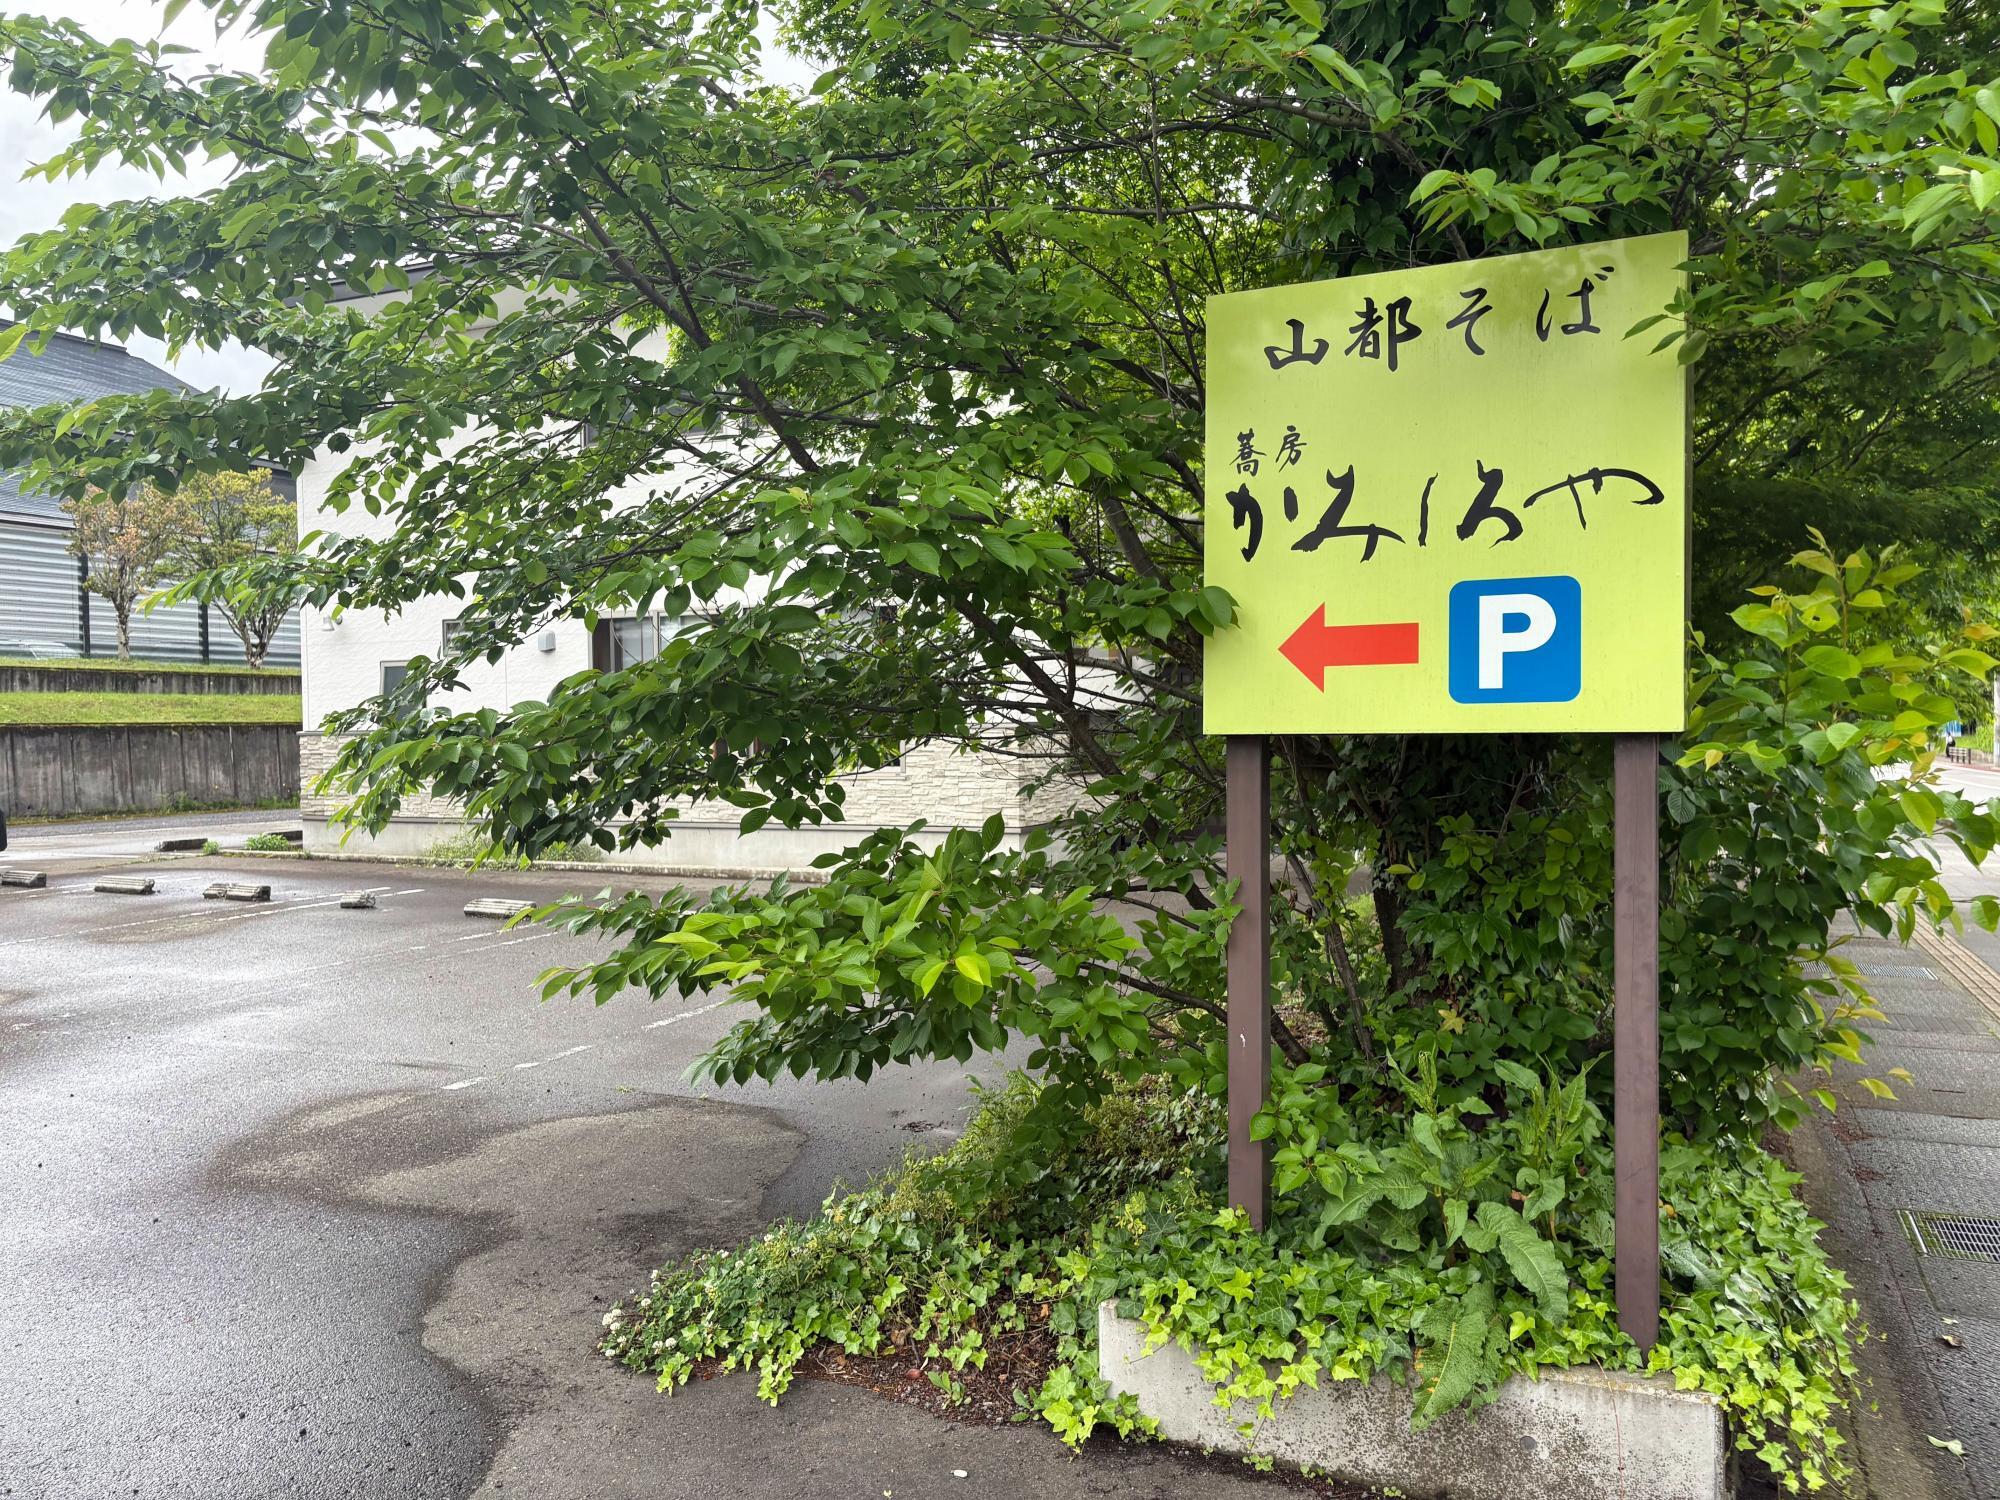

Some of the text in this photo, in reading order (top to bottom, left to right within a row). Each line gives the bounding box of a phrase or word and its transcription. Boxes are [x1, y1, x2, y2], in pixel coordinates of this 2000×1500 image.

[1264, 265, 1615, 372] 山都そば
[1229, 425, 1307, 477] 蕎房
[1225, 459, 1665, 563] かみしろや
[1479, 593, 1556, 689] P
